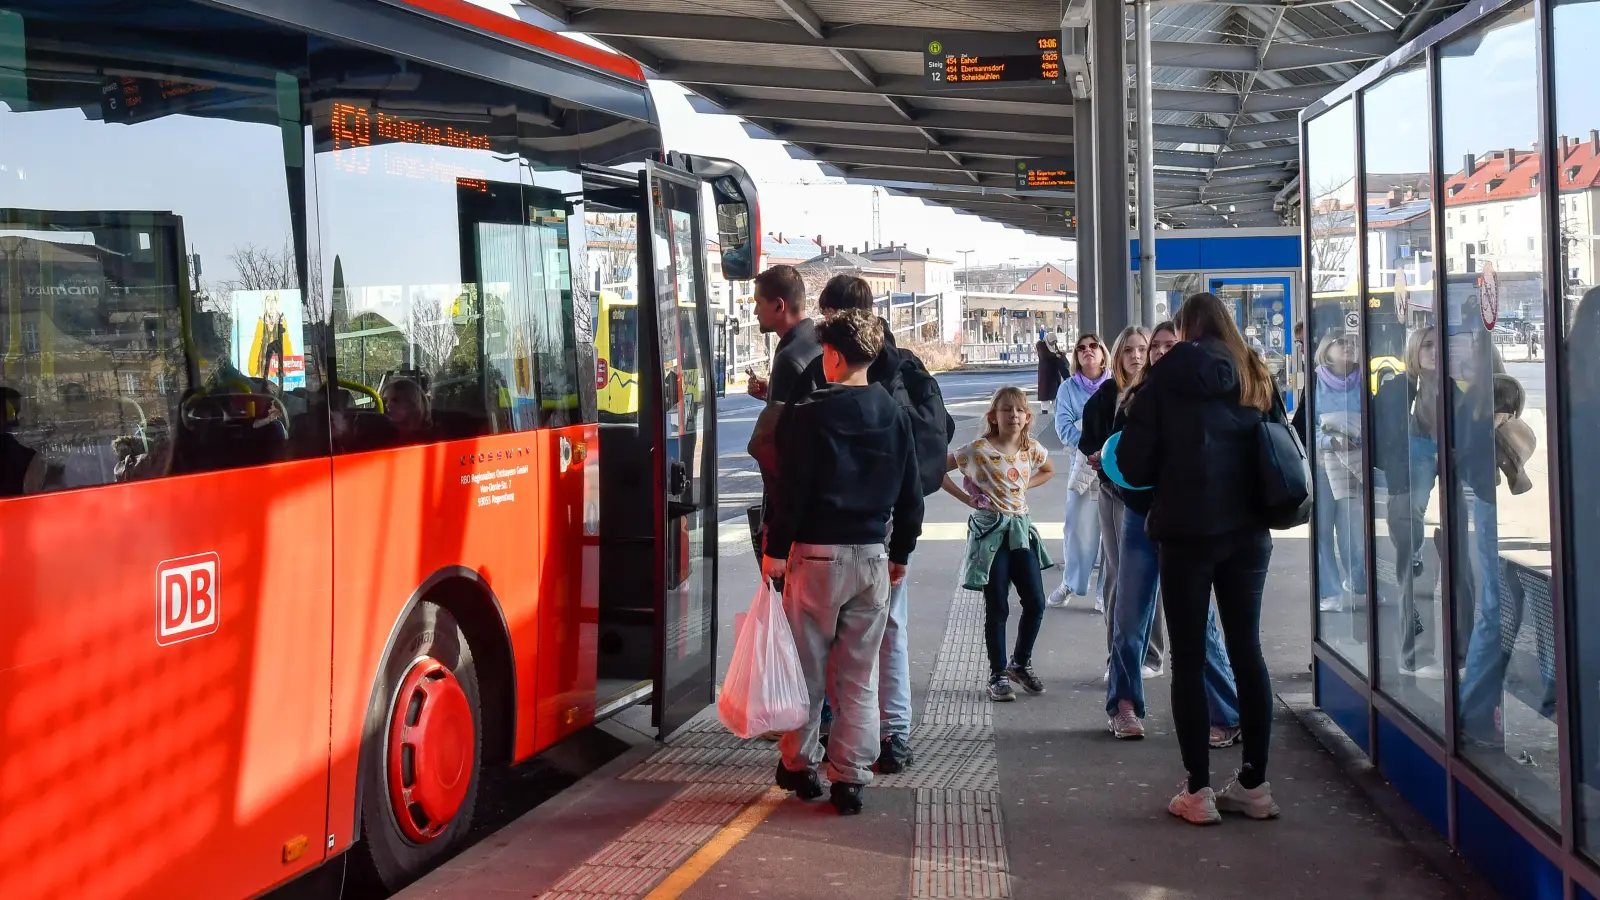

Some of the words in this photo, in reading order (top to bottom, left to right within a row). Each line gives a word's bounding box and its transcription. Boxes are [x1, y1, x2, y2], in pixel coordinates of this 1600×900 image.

[1038, 38, 1057, 49] 13:06
[928, 61, 943, 69] Steig
[946, 65, 957, 73] 454
[931, 72, 941, 81] 12
[946, 74, 958, 82] 454
[165, 568, 212, 630] DB
